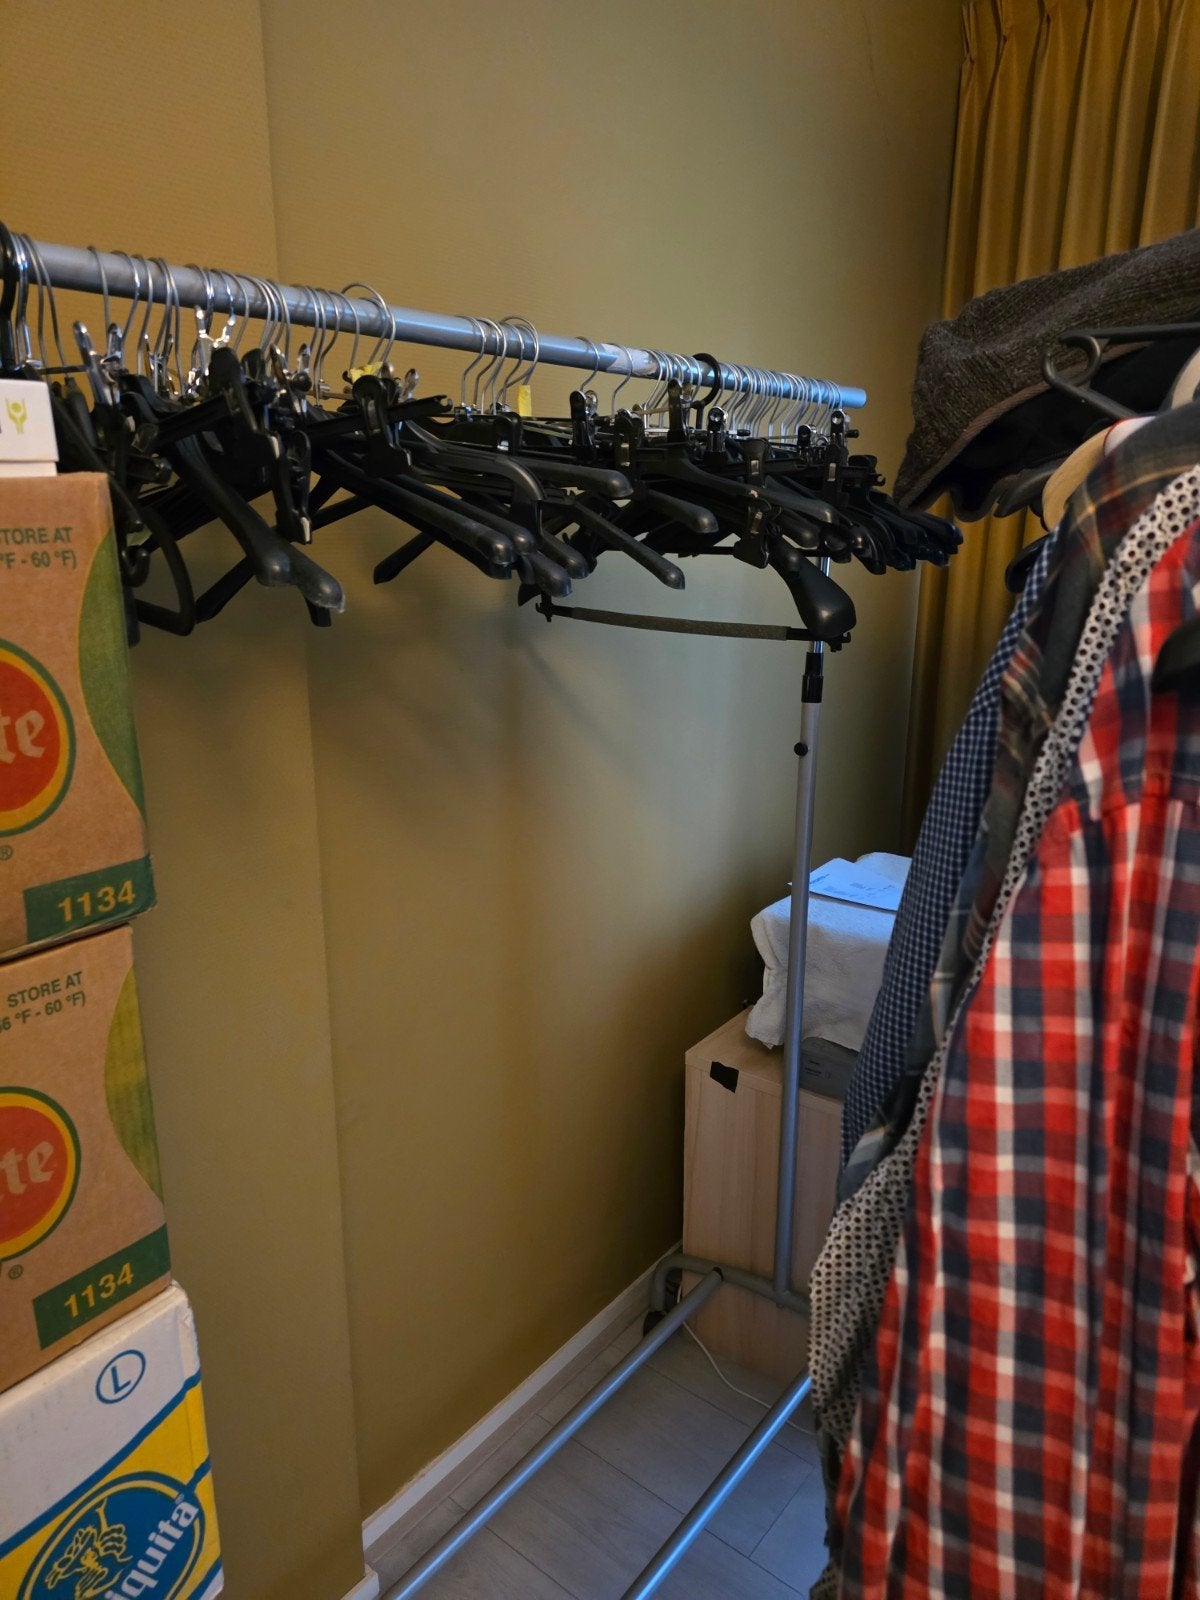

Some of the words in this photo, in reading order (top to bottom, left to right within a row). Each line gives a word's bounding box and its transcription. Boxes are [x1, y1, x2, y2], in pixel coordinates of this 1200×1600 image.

[0, 528, 48, 545] TORE
[52, 527, 72, 543] AT
[31, 550, 51, 568] 60
[58, 879, 136, 922] 1134
[7, 979, 61, 1008] STORE
[65, 971, 82, 989] AT
[0, 1016, 11, 1033] 6
[45, 999, 62, 1016] 60
[0, 1141, 55, 1194] te
[64, 1262, 134, 1318] 1134
[111, 1365, 131, 1395] L
